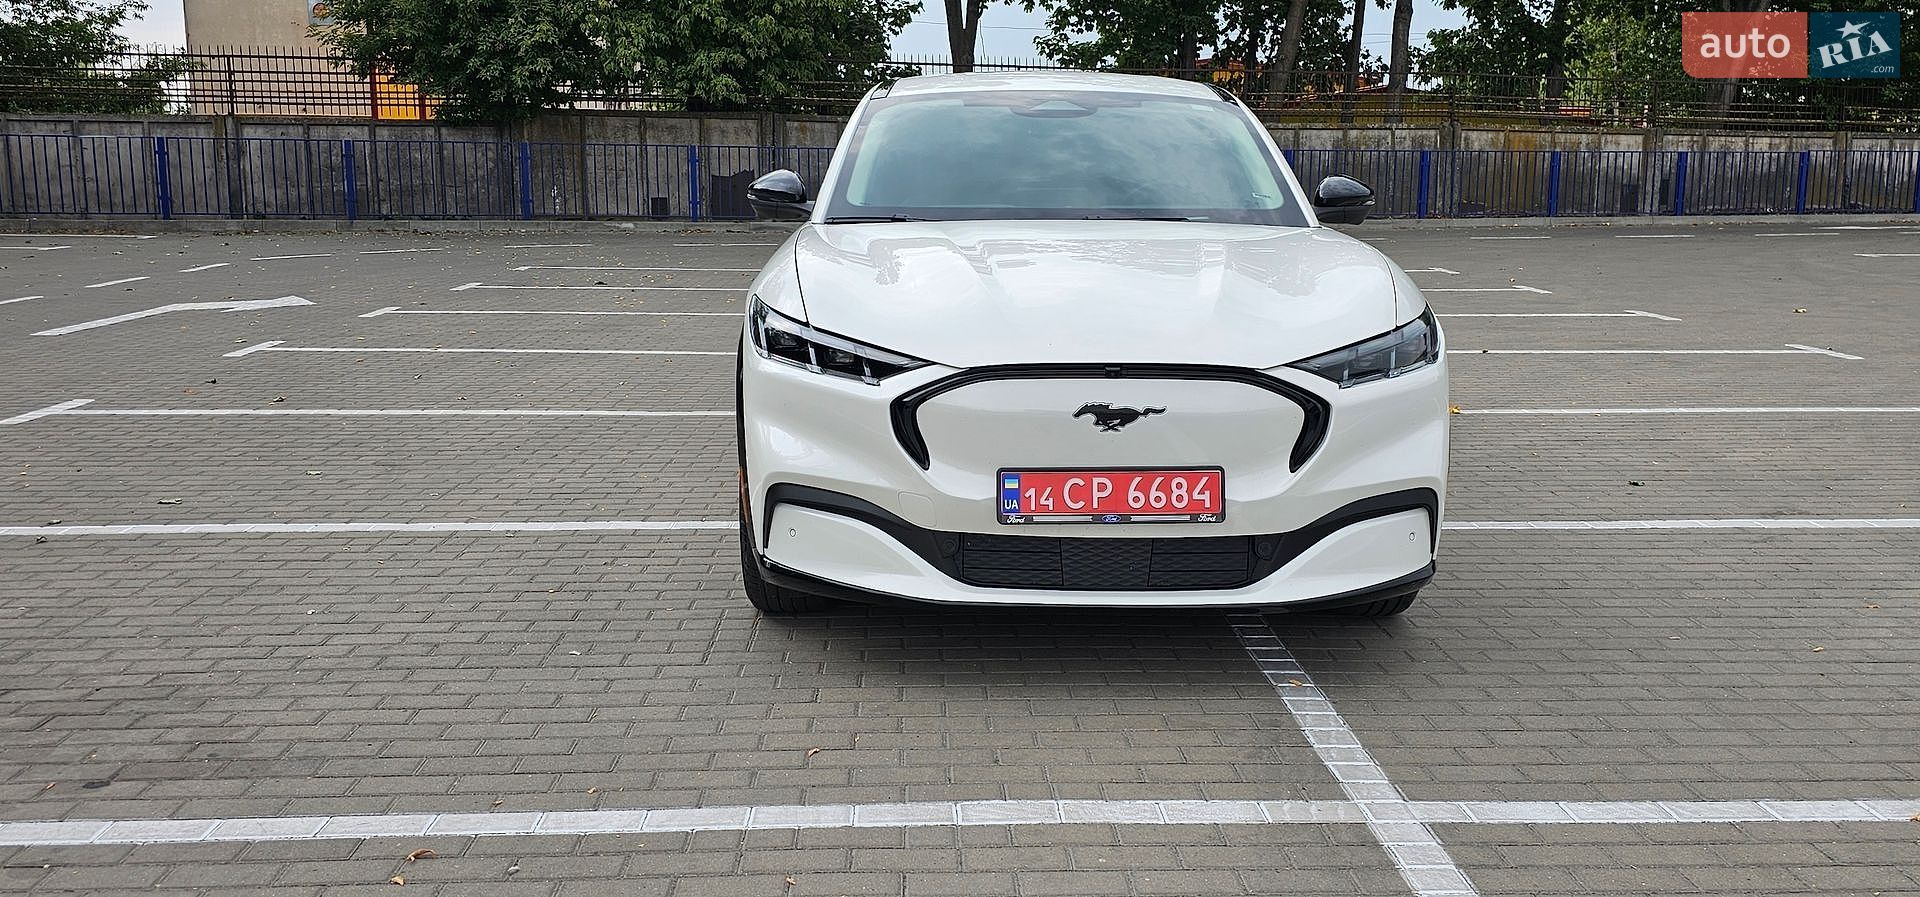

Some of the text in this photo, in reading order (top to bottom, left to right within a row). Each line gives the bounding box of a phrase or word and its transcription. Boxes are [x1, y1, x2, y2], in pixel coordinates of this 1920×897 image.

[1024, 476, 1211, 511] 14 CP 6684
[1004, 500, 1019, 510] UA
[1007, 514, 1025, 523] Ford
[1197, 513, 1217, 522] Ford
